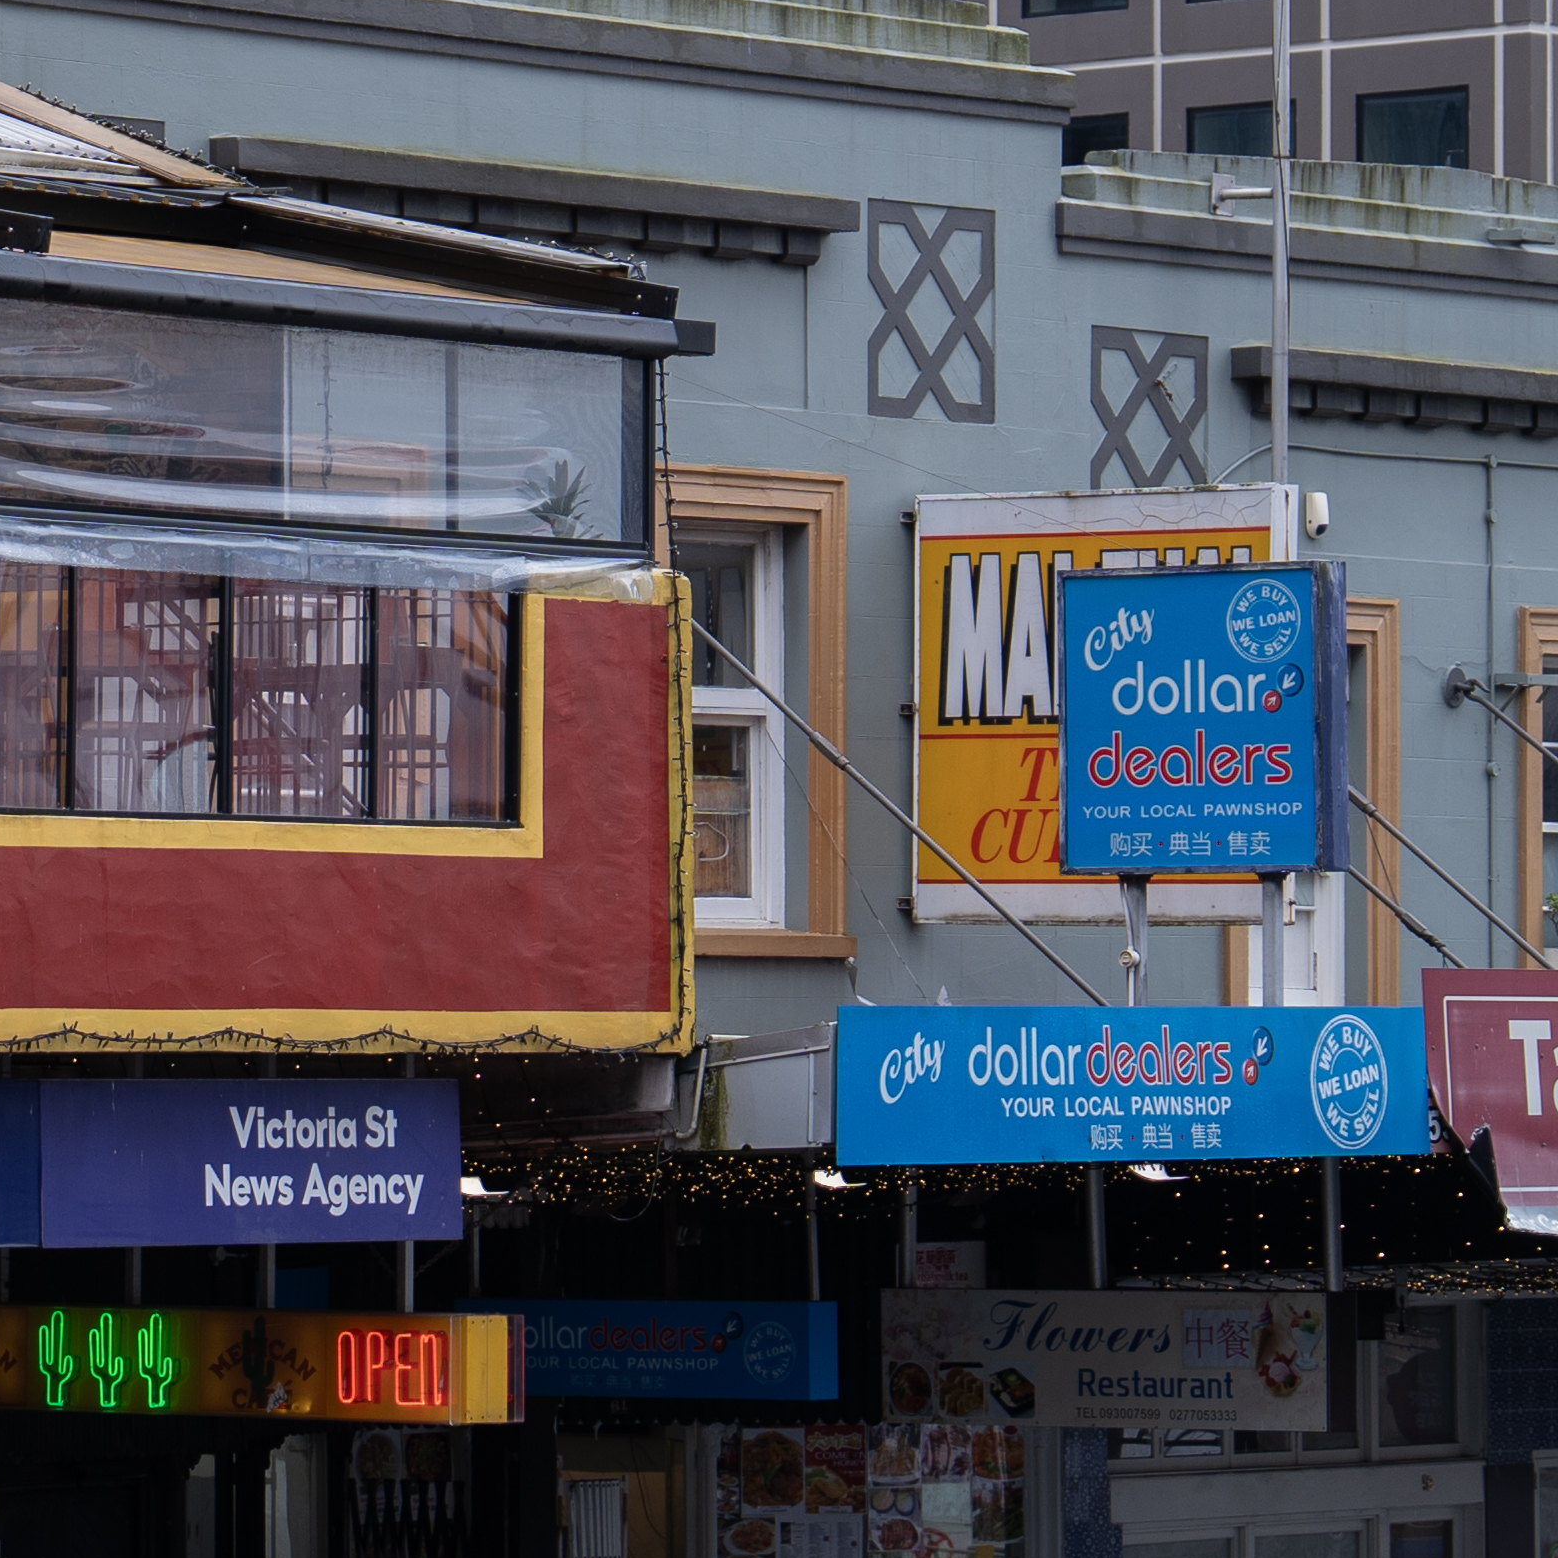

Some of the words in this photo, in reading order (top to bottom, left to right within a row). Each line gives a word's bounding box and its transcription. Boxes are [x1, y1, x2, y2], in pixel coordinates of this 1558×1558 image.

[1236, 589, 1257, 613] WE
[1261, 585, 1290, 607] BUY
[1257, 609, 1297, 628] LOAN
[1083, 607, 1156, 672] City
[1239, 632, 1260, 656] WE
[1263, 626, 1292, 656] SELL
[1111, 658, 1268, 716] dollar
[1087, 728, 1293, 789] dealers
[1082, 804, 1132, 819] YOUR
[1140, 803, 1197, 819] LOCAL
[1203, 801, 1303, 817] PAWNSHOP
[1109, 831, 1154, 858] 购买
[1167, 830, 1212, 857] 典当
[1226, 829, 1272, 856] 售卖
[879, 1030, 947, 1105] City
[1318, 1032, 1340, 1071] WE
[1341, 1026, 1373, 1057] BUY
[1317, 1076, 1343, 1100] WE
[1343, 1063, 1380, 1091] LOAN
[228, 1105, 357, 1150] Victoria
[362, 1104, 398, 1149] St
[1001, 1096, 1056, 1118] YOUR
[1063, 1096, 1125, 1118] LOCAL
[1131, 1095, 1233, 1117] PAWNSHOP
[1326, 1101, 1350, 1137] WE
[1353, 1088, 1380, 1137] SELL
[1089, 1124, 1124, 1151] 购买
[1141, 1122, 1175, 1150] 典当
[1190, 1121, 1223, 1149] 售卖
[204, 1163, 295, 1208] News
[301, 1161, 426, 1217] Agency
[982, 1299, 1172, 1355] Flowers
[1186, 1317, 1251, 1362] 中餐
[206, 1334, 320, 1382] MEXICAN
[335, 1327, 450, 1408] OPEN
[567, 1356, 621, 1371] LOCAL
[626, 1357, 720, 1372] PAWNSHOP
[1076, 1368, 1235, 1401] Restaurant
[1098, 1407, 1162, 1421] 093007599
[1168, 1408, 1239, 1423] 0277053333
